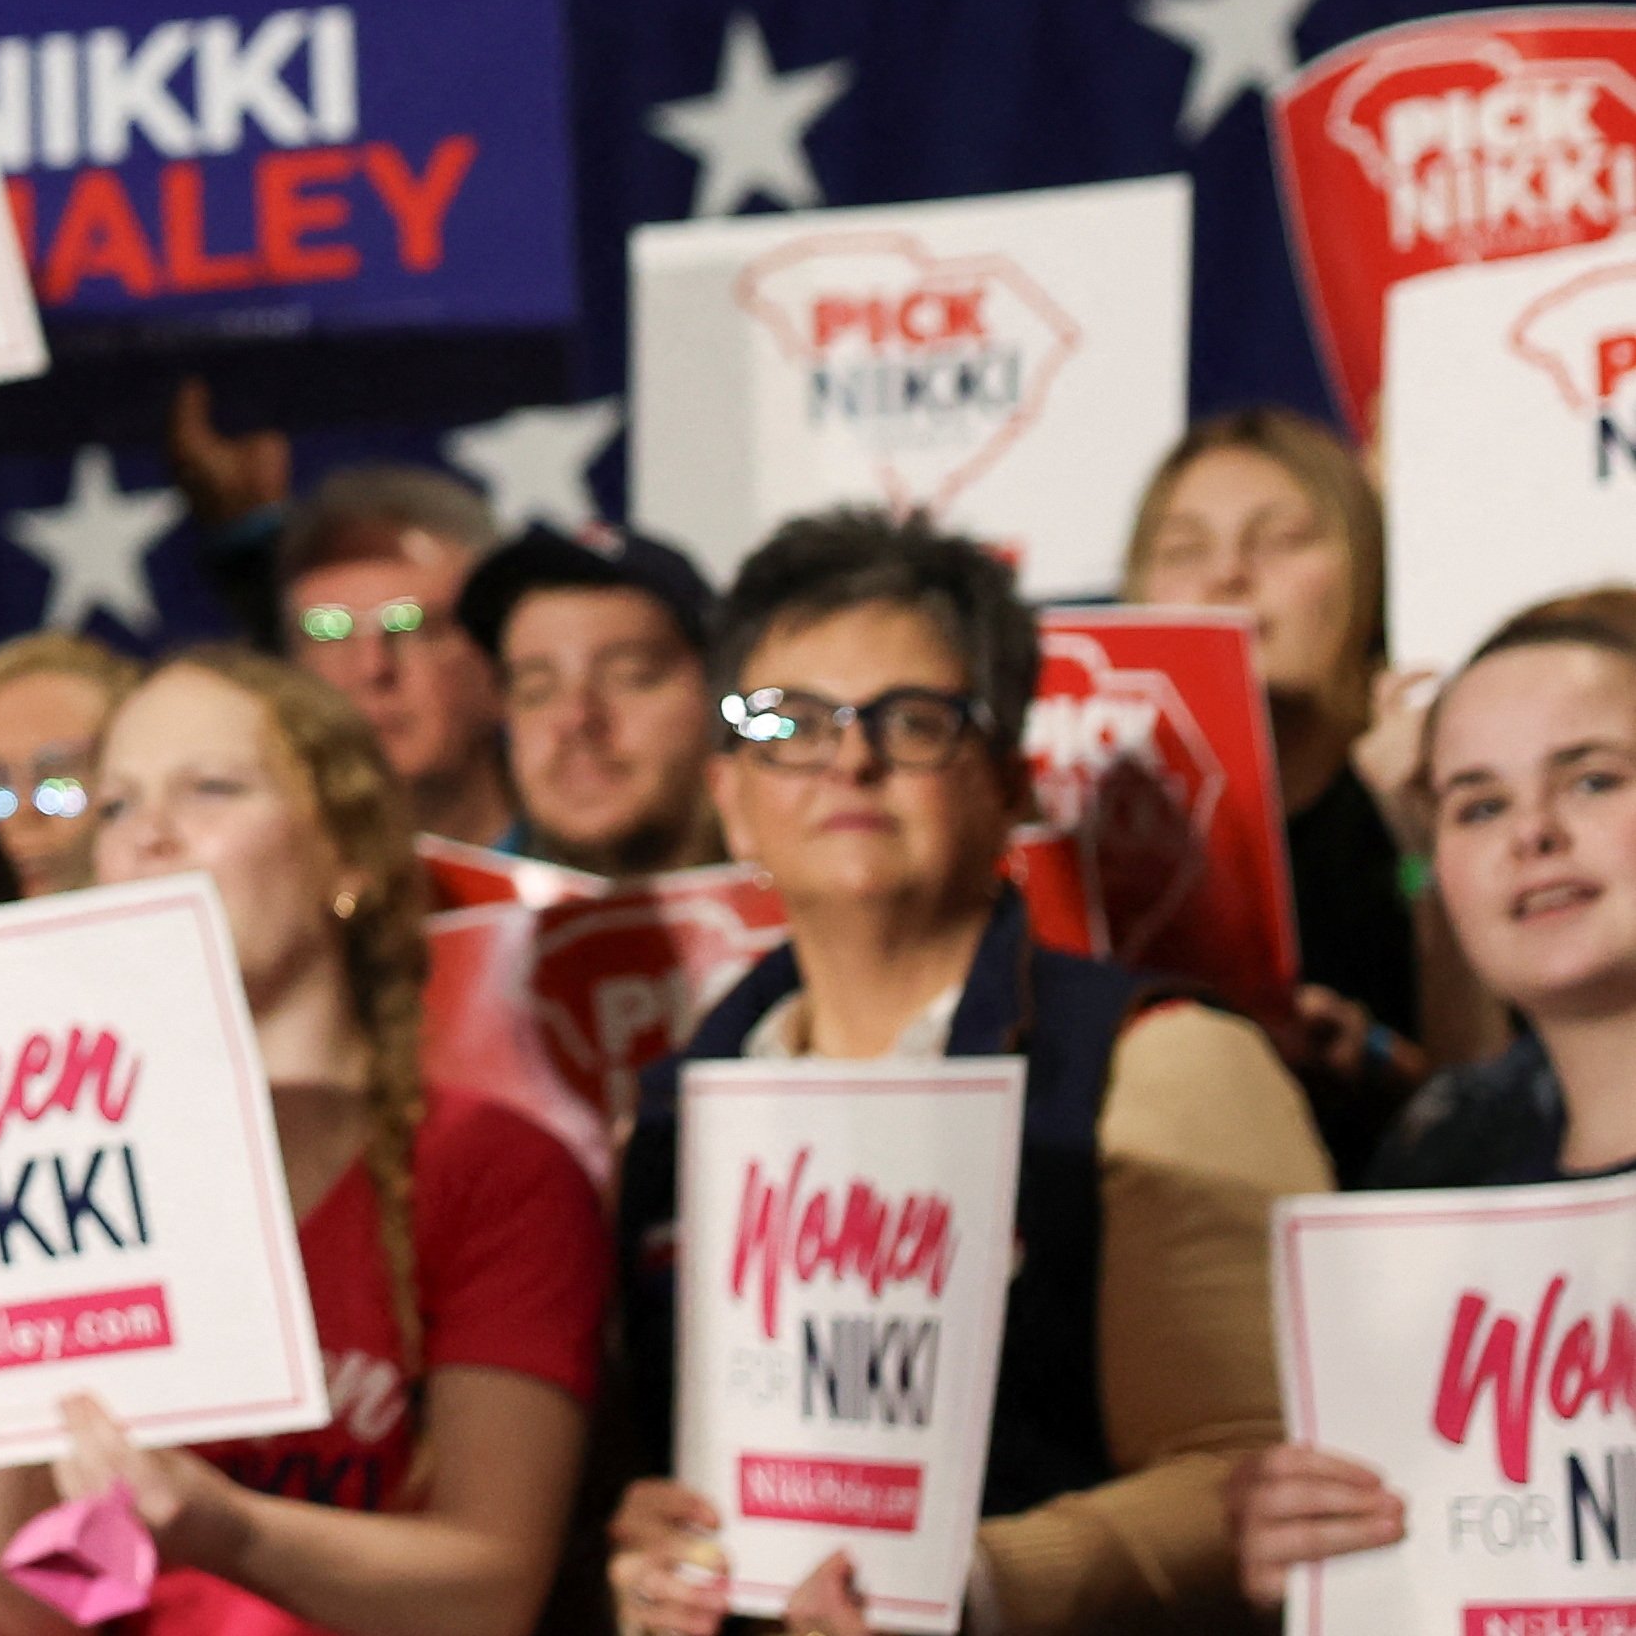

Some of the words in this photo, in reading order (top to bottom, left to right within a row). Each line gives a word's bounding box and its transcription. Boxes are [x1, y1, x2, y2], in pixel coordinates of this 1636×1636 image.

[1383, 82, 1604, 172] PICK
[810, 284, 988, 352] PICK
[726, 1144, 962, 1344] Women
[1446, 1492, 1558, 1558] FOR
